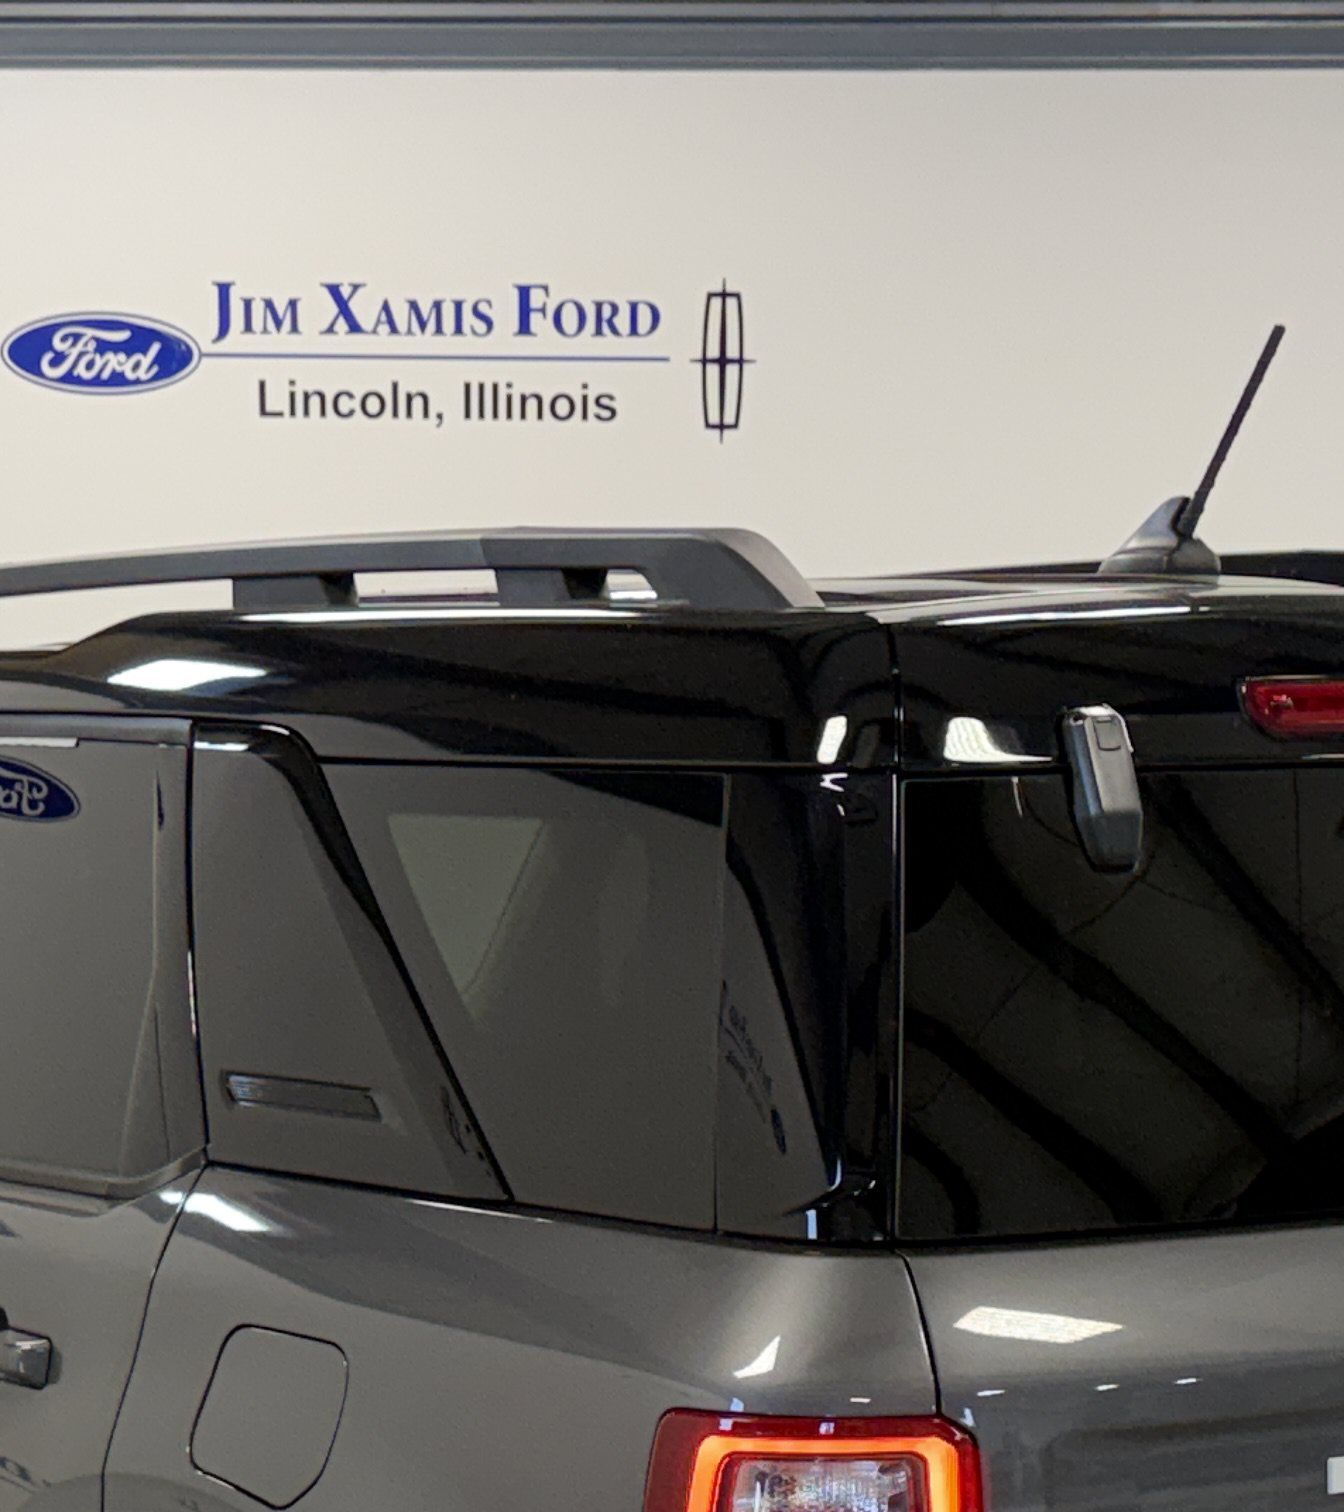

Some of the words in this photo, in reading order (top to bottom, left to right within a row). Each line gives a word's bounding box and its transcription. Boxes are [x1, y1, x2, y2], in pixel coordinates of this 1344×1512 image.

[211, 280, 301, 343] JIM
[319, 282, 495, 337] XAMIS
[512, 284, 662, 338] FORD
[39, 325, 160, 382] Ford
[258, 379, 445, 428] Lincoln,
[462, 381, 619, 423] Illinois
